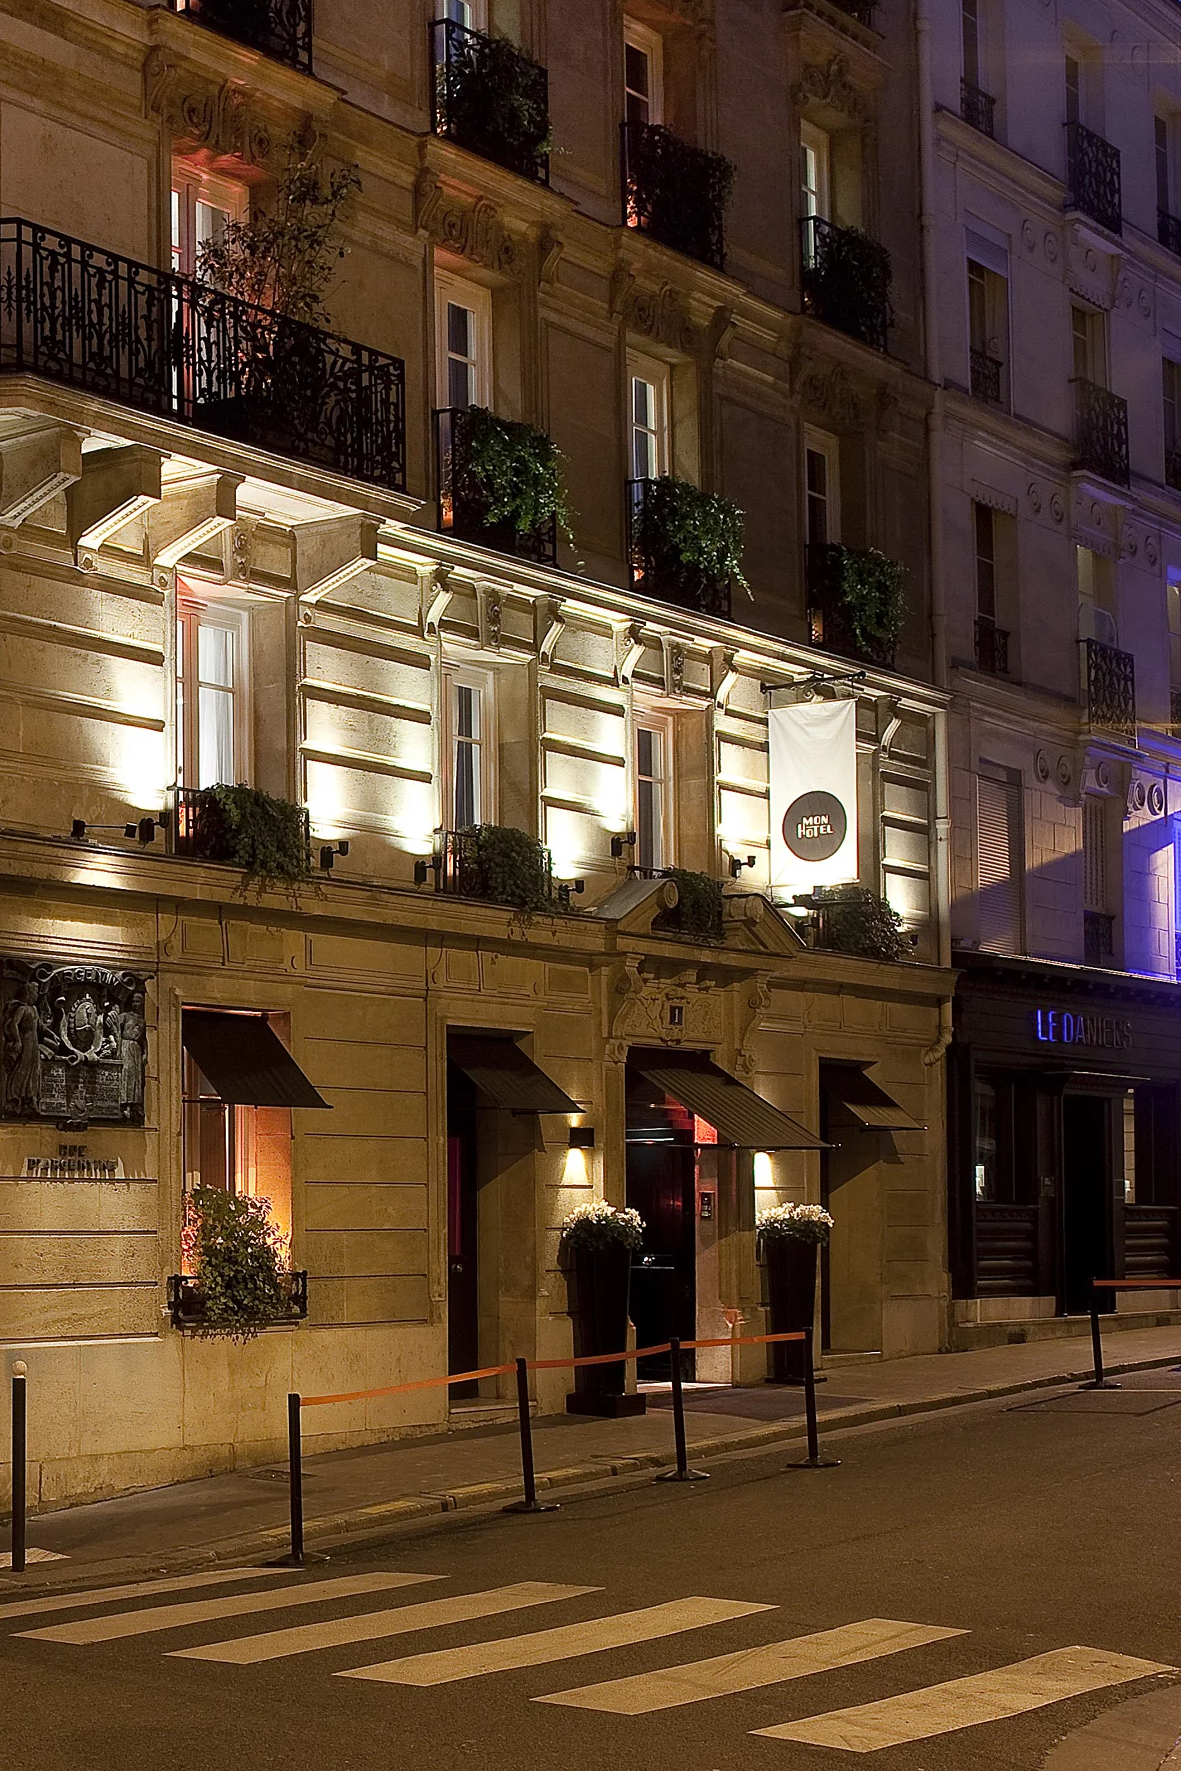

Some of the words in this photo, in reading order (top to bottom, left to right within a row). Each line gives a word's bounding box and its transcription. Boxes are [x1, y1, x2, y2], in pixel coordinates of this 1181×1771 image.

[802, 815, 829, 825] MON
[797, 823, 833, 839] HOTEL
[1036, 1009, 1058, 1042] LE
[59, 1144, 87, 1157] RUE
